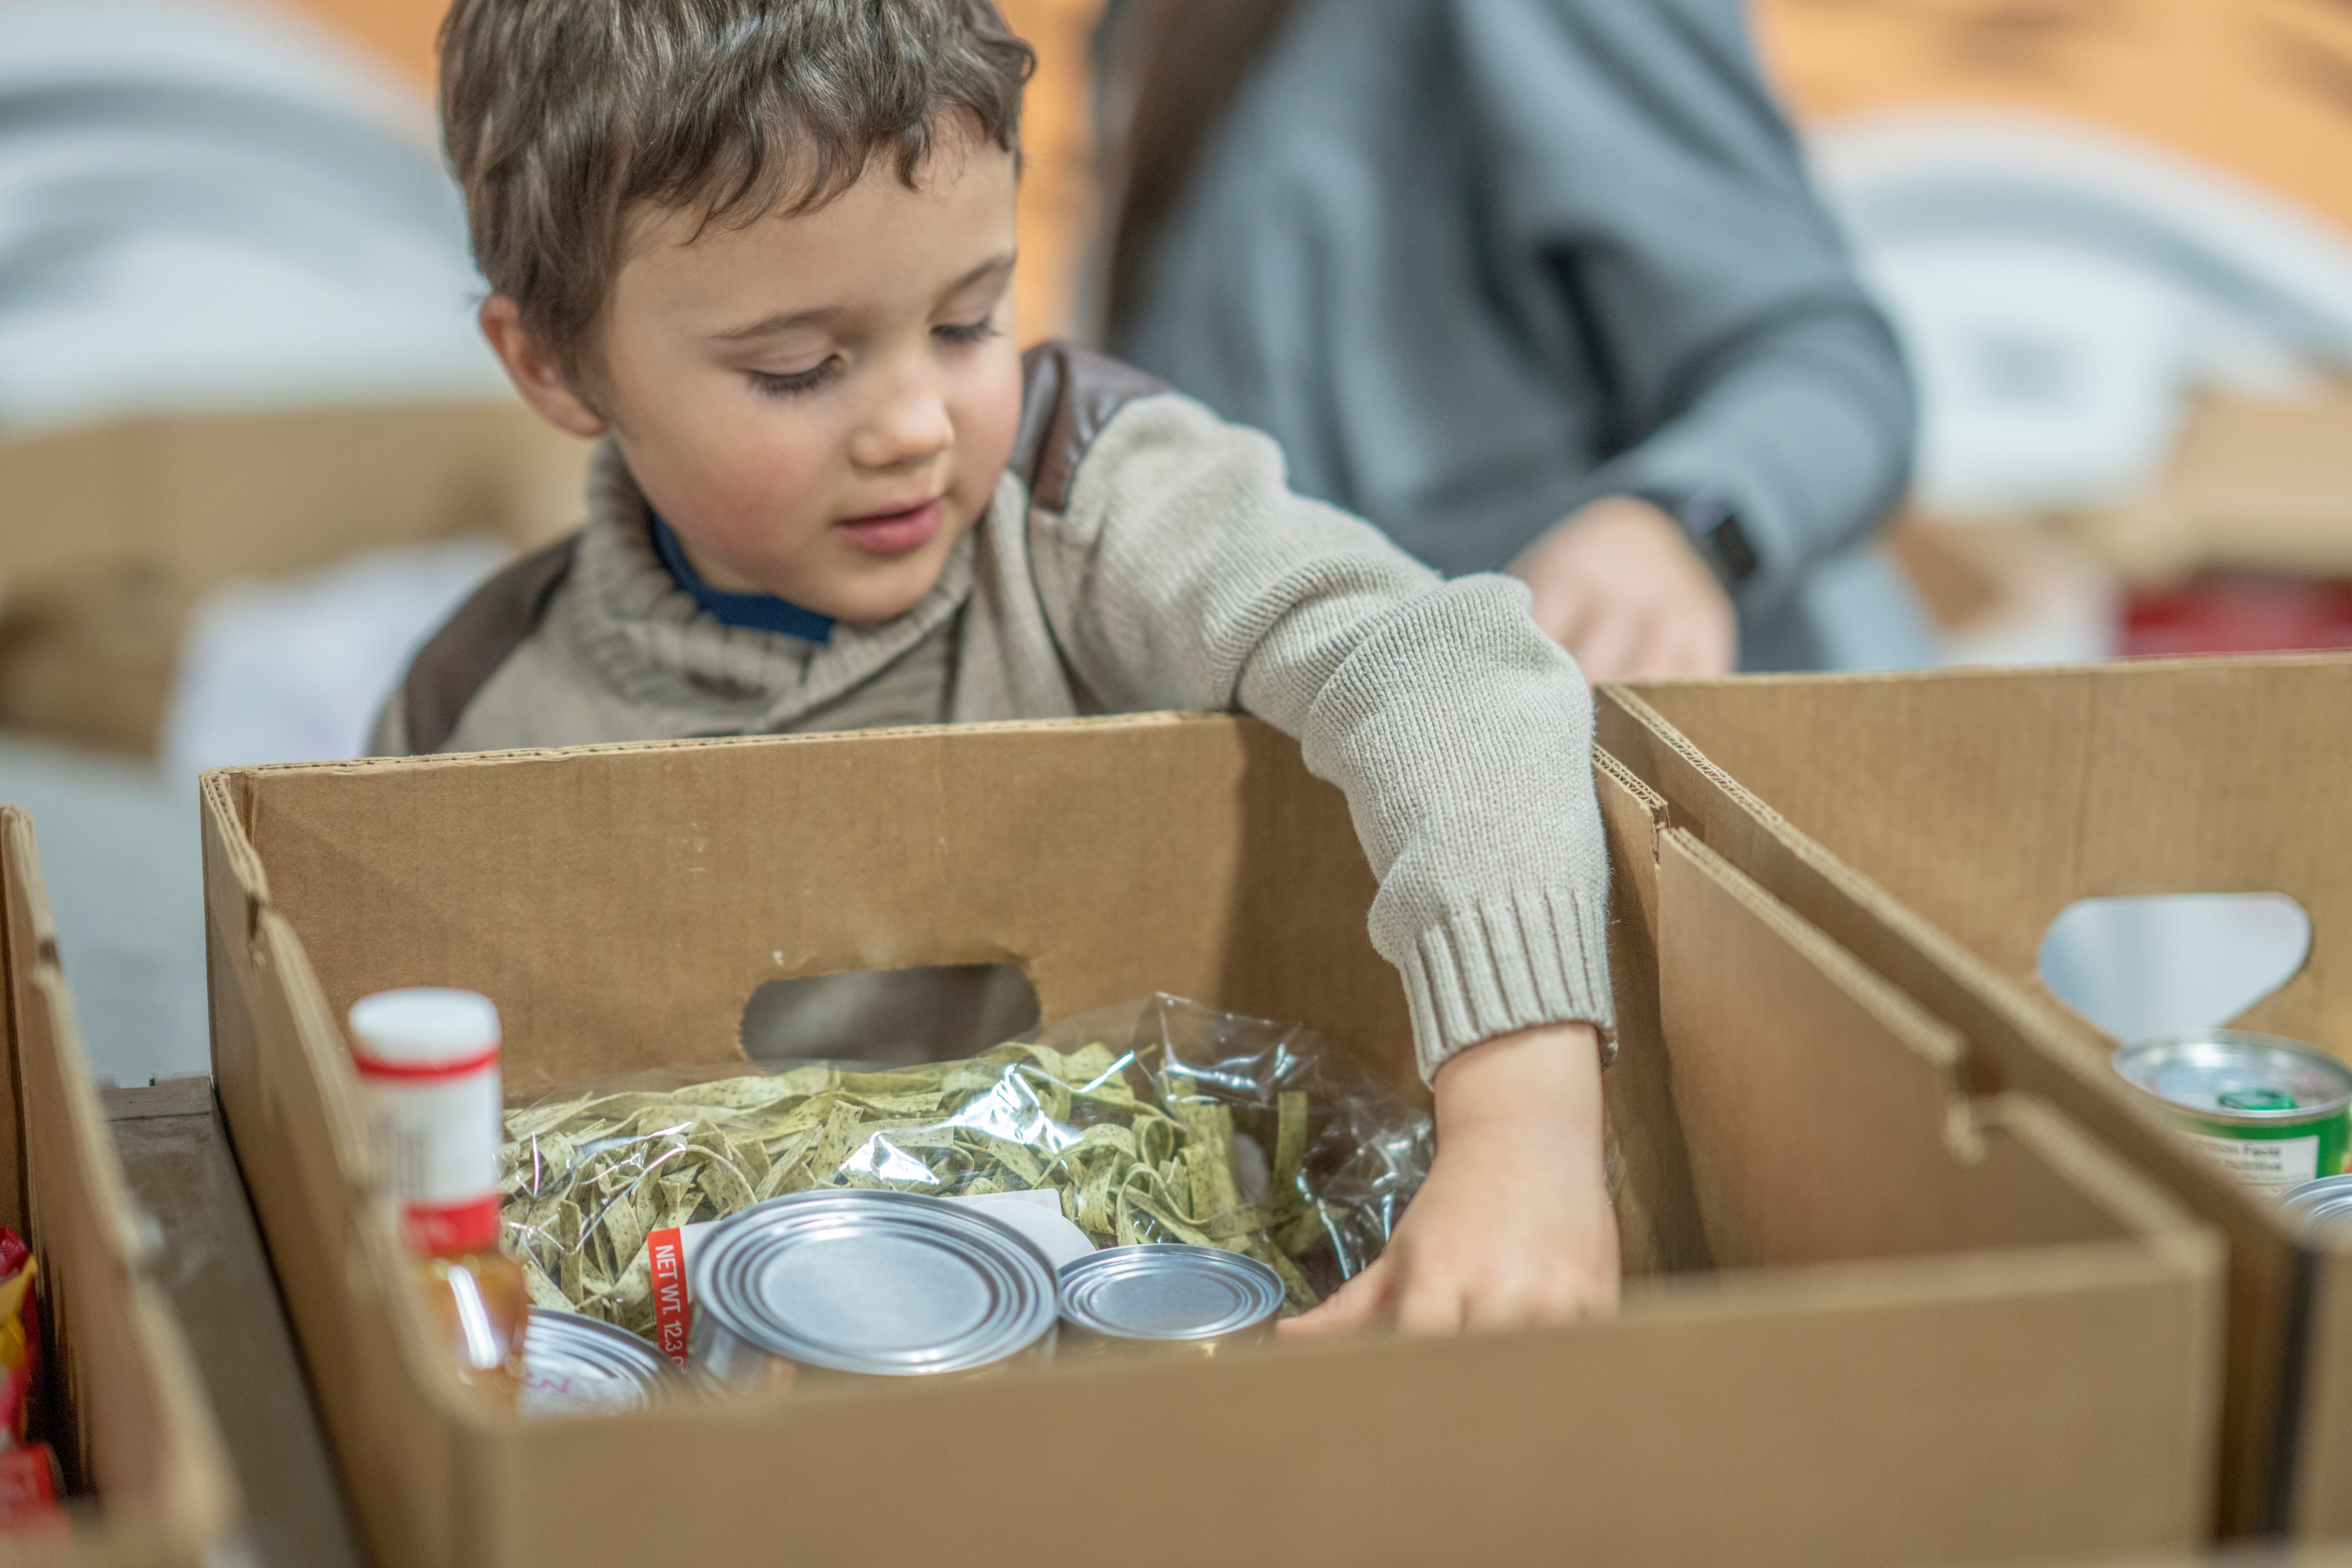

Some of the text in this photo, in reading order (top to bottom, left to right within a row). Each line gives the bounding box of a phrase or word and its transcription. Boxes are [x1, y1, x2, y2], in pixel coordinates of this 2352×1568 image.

[655, 1244, 678, 1280] NET
[660, 1284, 681, 1315] WT.
[663, 1319, 683, 1352] 12.3
